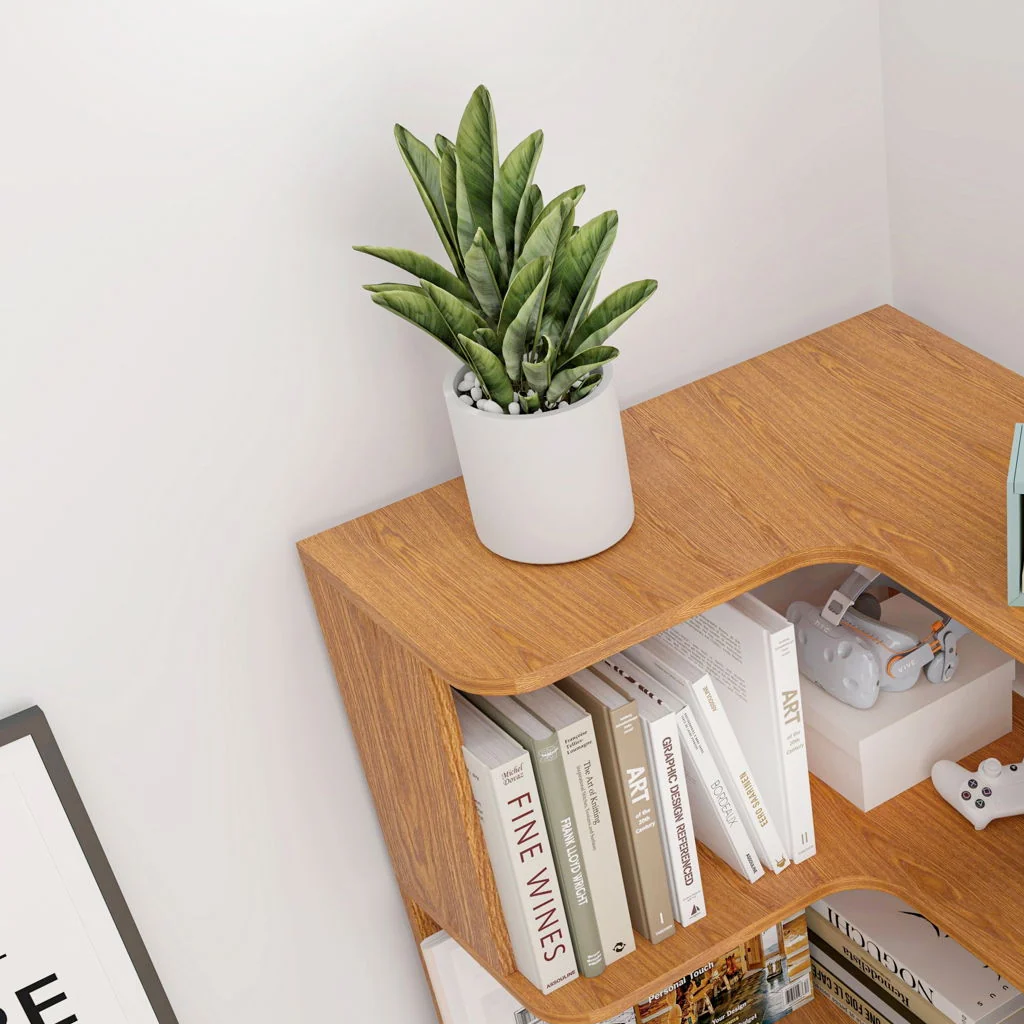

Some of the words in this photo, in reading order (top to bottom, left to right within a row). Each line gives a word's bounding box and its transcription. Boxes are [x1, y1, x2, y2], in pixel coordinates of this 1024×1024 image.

[782, 689, 801, 725] ART
[583, 760, 591, 775] The
[662, 736, 678, 784] GRAPHIC
[586, 775, 594, 787] Art
[626, 767, 649, 804] ART
[739, 771, 760, 810] SAARINEN
[590, 794, 601, 826] Knitting
[670, 784, 684, 823] DESIGN
[710, 779, 740, 828] BORDEAUX
[756, 807, 768, 828] EERO
[560, 816, 574, 847] FRANK
[567, 845, 581, 873] LLOYD
[676, 822, 695, 887] REFERENCED
[508, 791, 543, 864] FINE
[527, 866, 567, 962] WINES
[572, 869, 589, 906] WRIGHT
[827, 907, 934, 1005] NOGUCHI
[546, 969, 576, 989] ASSOULINE
[649, 976, 687, 1004] Personal
[834, 985, 844, 1000] LE
[842, 945, 910, 1008] Remodelista
[711, 1013, 726, 1024] Your
[727, 1001, 748, 1017] Design
[845, 995, 864, 1016] FOIS
